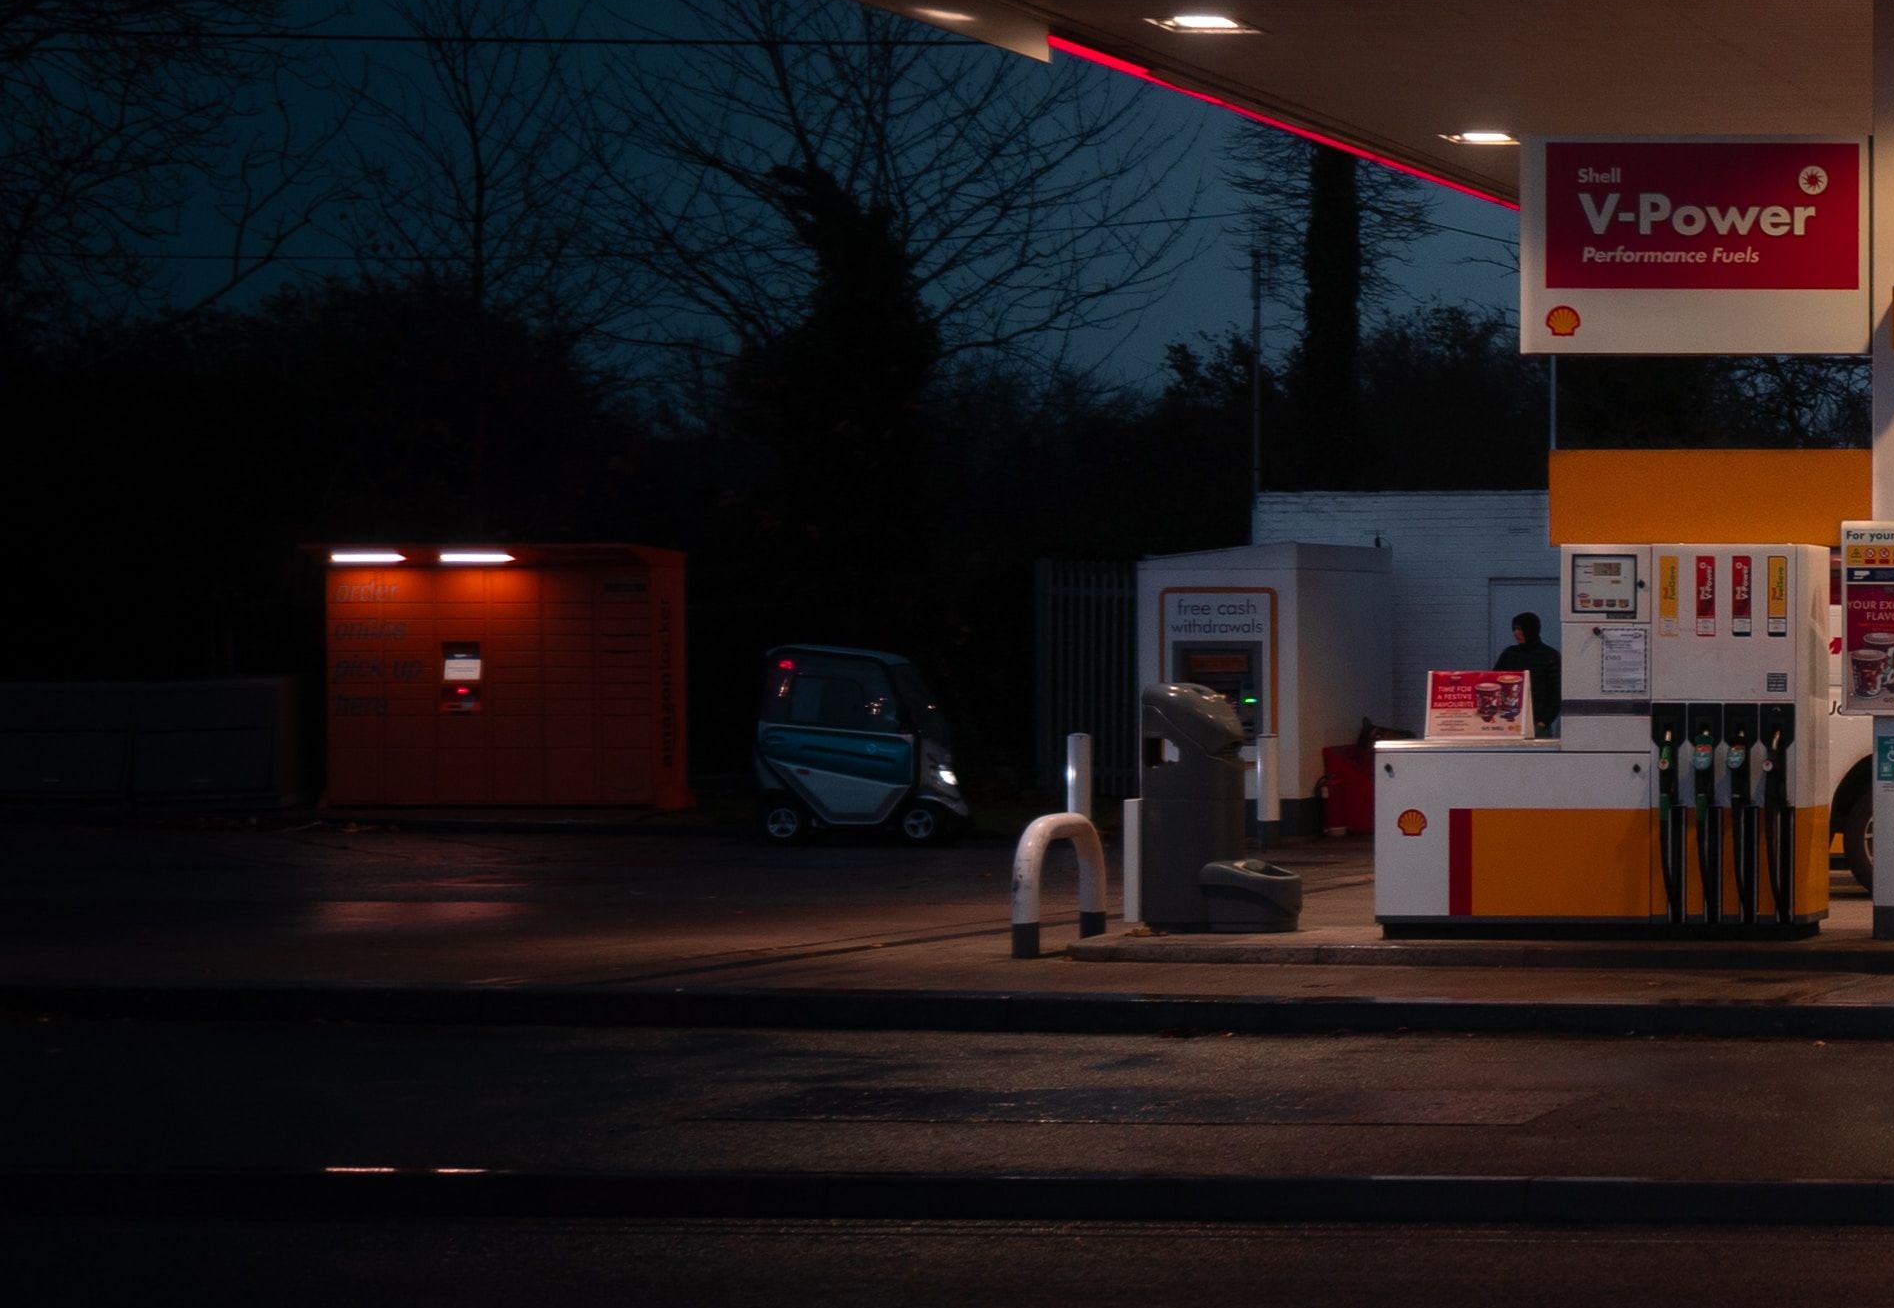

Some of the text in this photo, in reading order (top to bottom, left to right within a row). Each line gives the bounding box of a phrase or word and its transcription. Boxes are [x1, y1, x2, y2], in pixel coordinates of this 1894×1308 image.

[1576, 167, 1622, 184] Shell
[1577, 193, 1816, 237] V-Power
[1581, 246, 1760, 264] Performance Fuels
[1846, 530, 1865, 540] For
[1177, 598, 1257, 616] free cash
[1171, 619, 1264, 634] withdrawals
